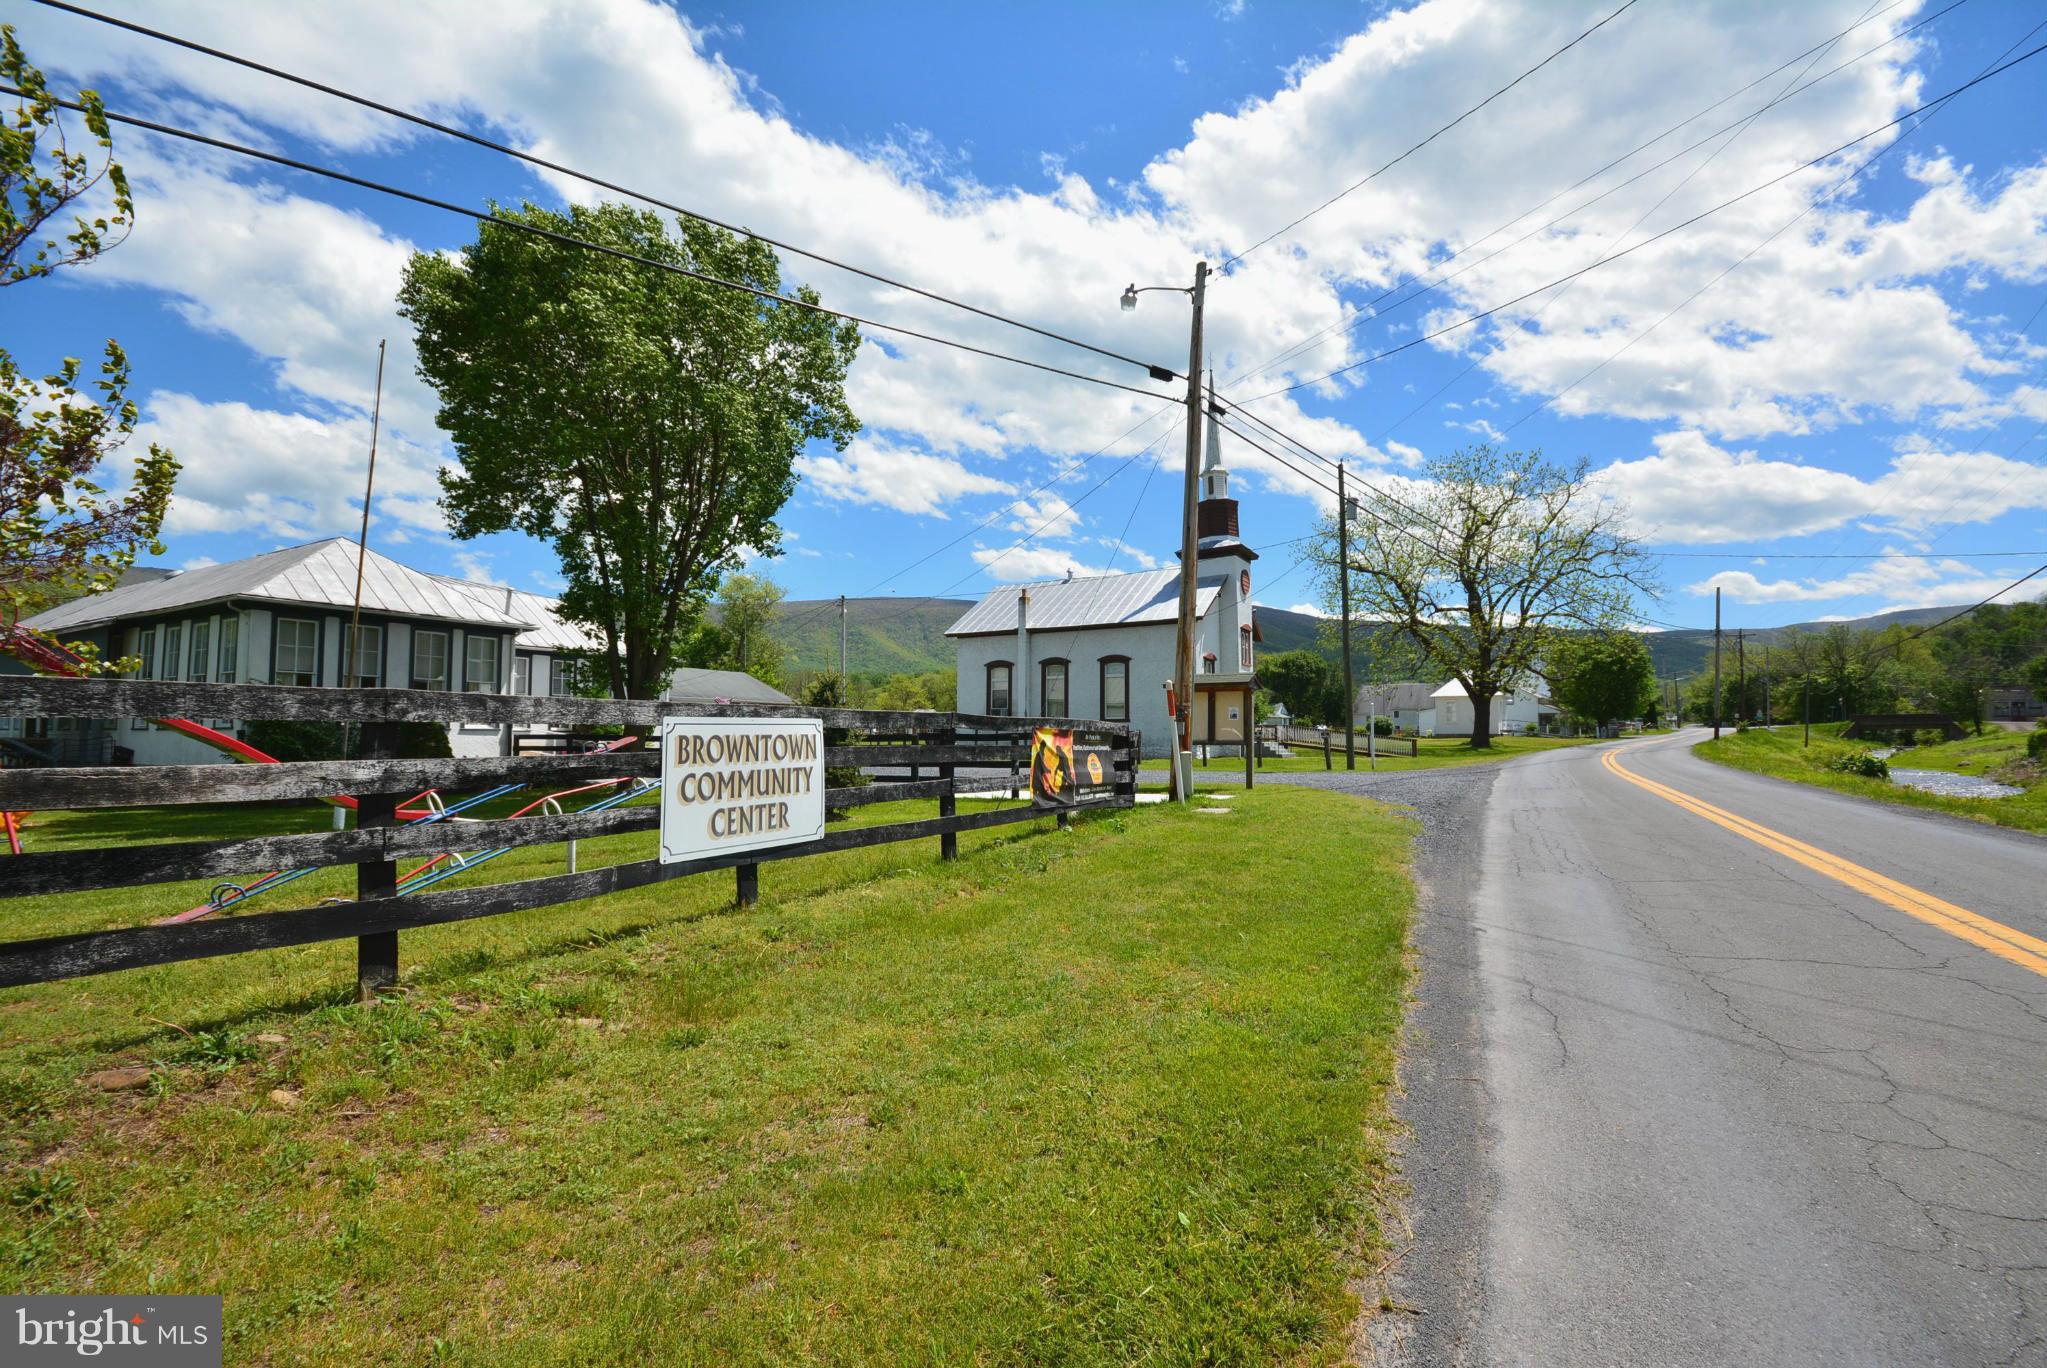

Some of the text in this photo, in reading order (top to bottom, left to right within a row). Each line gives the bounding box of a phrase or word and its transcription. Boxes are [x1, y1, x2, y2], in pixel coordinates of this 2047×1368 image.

[675, 734, 817, 768] BROWNTOWN
[677, 766, 814, 806] COMMUNITY
[707, 801, 790, 841] CENTER
